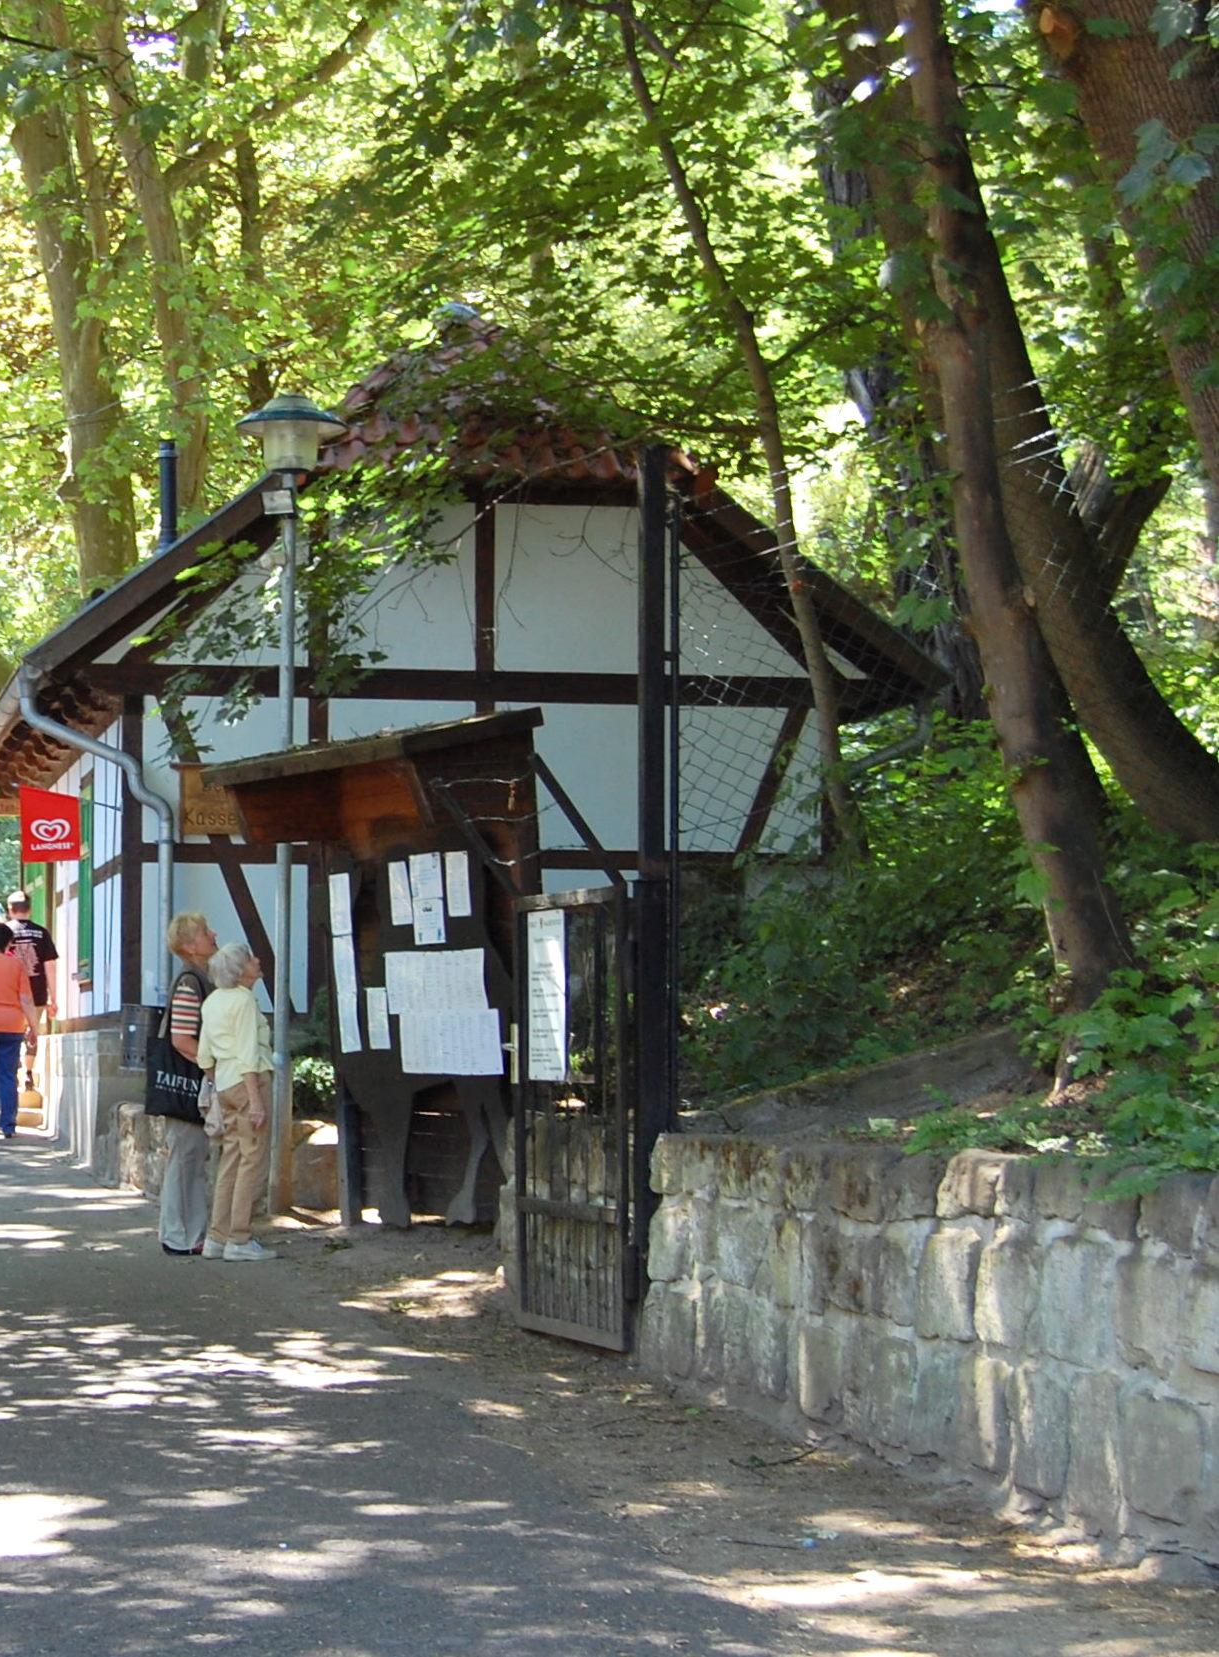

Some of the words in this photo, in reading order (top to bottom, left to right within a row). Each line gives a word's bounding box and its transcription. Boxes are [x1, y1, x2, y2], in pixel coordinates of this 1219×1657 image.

[184, 807, 237, 825] Kasse
[30, 842, 72, 851] LANGNESE
[156, 1070, 199, 1092] TAIFUN
